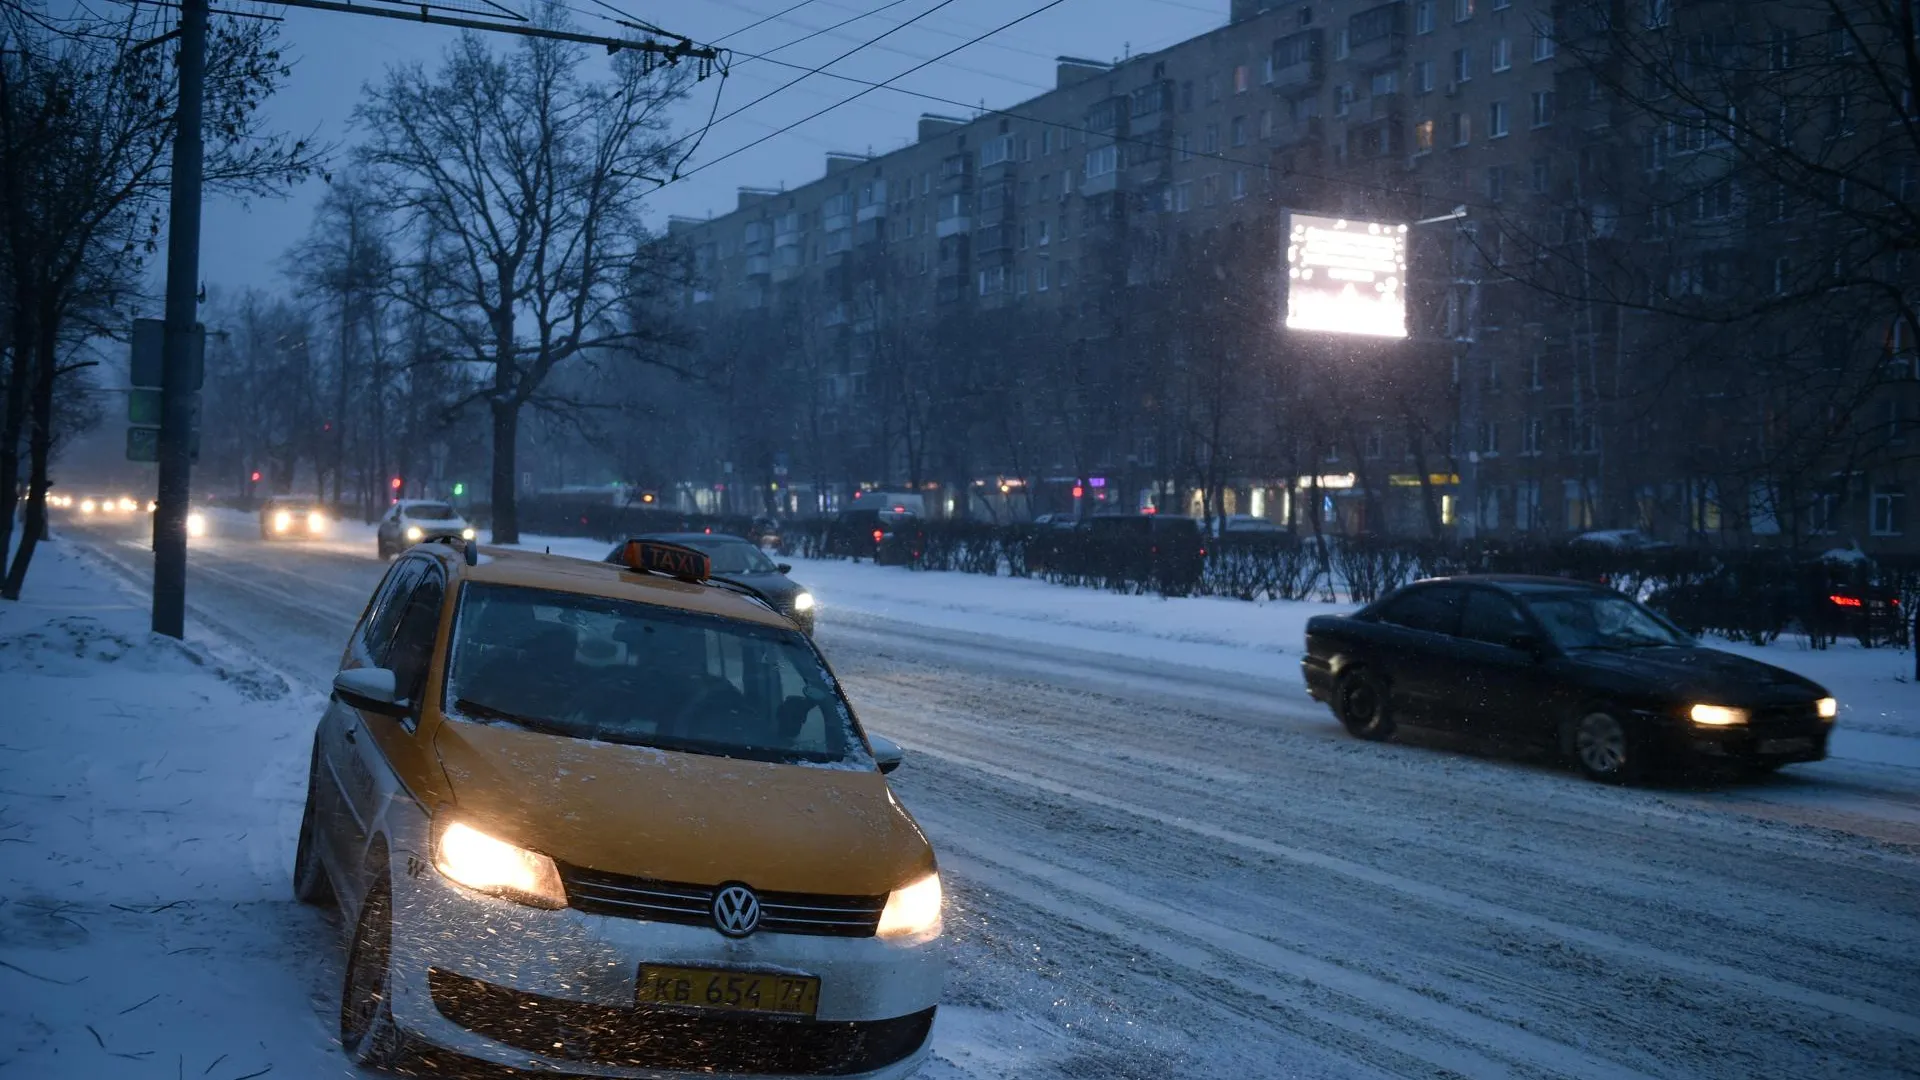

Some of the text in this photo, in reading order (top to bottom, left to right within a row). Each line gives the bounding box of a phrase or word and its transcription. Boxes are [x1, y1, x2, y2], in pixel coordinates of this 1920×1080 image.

[651, 549, 695, 575] TAXI
[715, 887, 760, 934] VW
[706, 976, 761, 1007] 654
[781, 979, 809, 1005] 77
